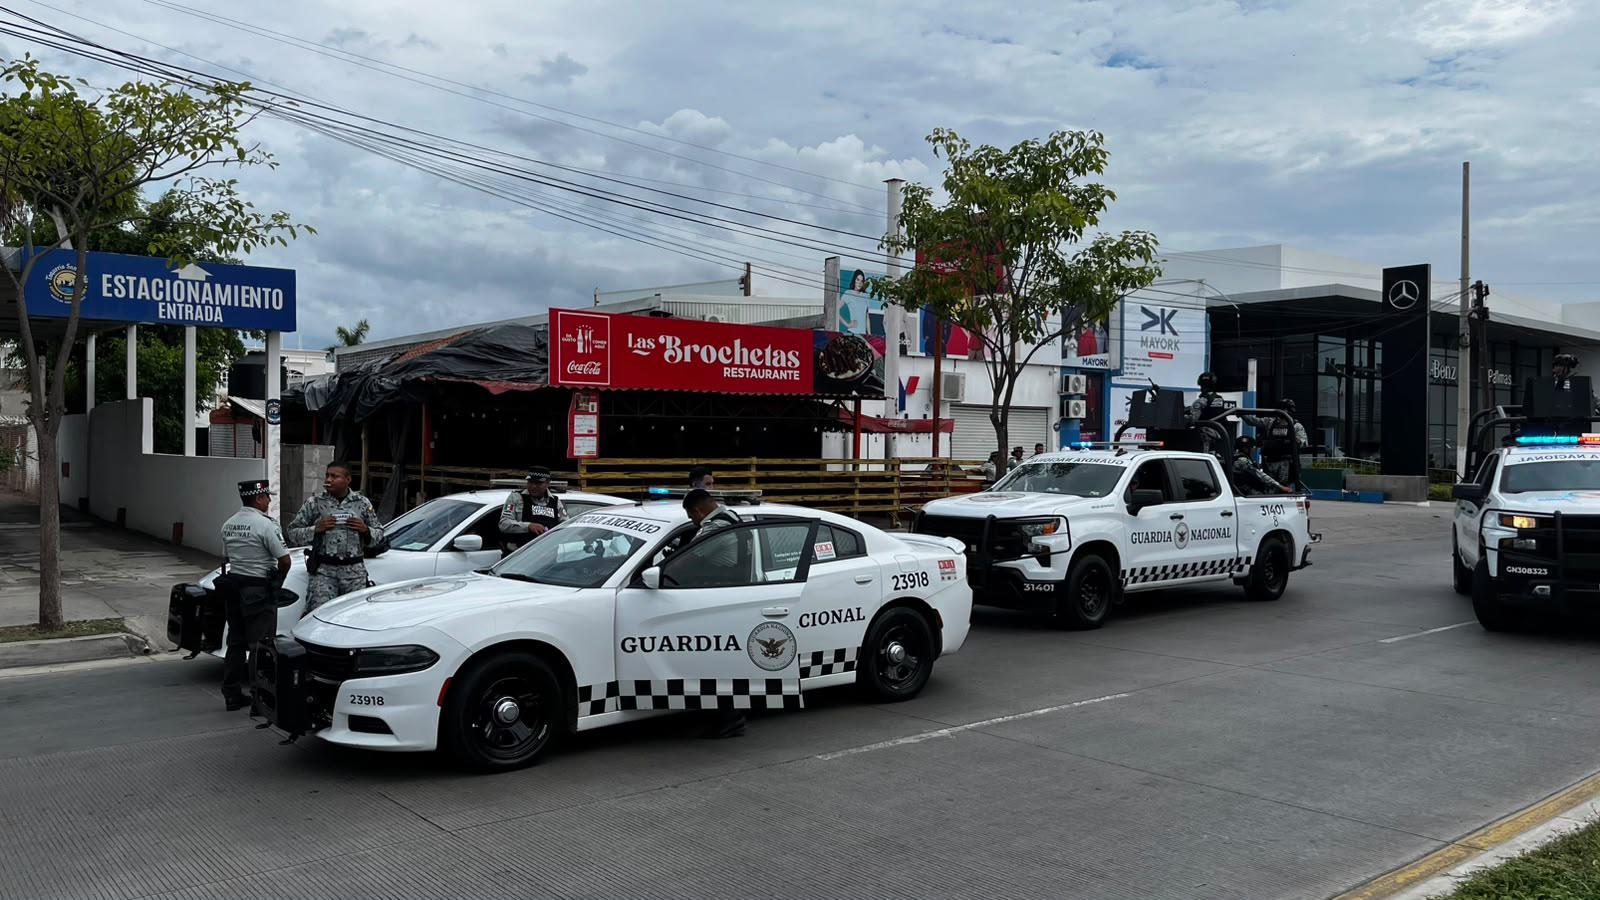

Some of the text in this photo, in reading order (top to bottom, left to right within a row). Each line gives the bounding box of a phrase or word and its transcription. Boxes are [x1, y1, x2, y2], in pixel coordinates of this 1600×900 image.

[102, 273, 284, 311] ESTACIONAMIENTO
[158, 302, 223, 323] ENTRADA
[628, 333, 801, 369] Las Brochetas
[1140, 336, 1180, 351] MAYORK
[1082, 357, 1109, 367] MAYORK
[723, 366, 801, 381] RESTAURANTE
[1260, 504, 1285, 516] 31401
[1131, 527, 1232, 545] GUARDIA NACIONAL
[891, 571, 929, 591] 23918
[1023, 583, 1055, 592] 31401
[798, 607, 866, 629] CIONAL
[620, 635, 742, 654] GUARDIA
[350, 694, 385, 706] 23918
